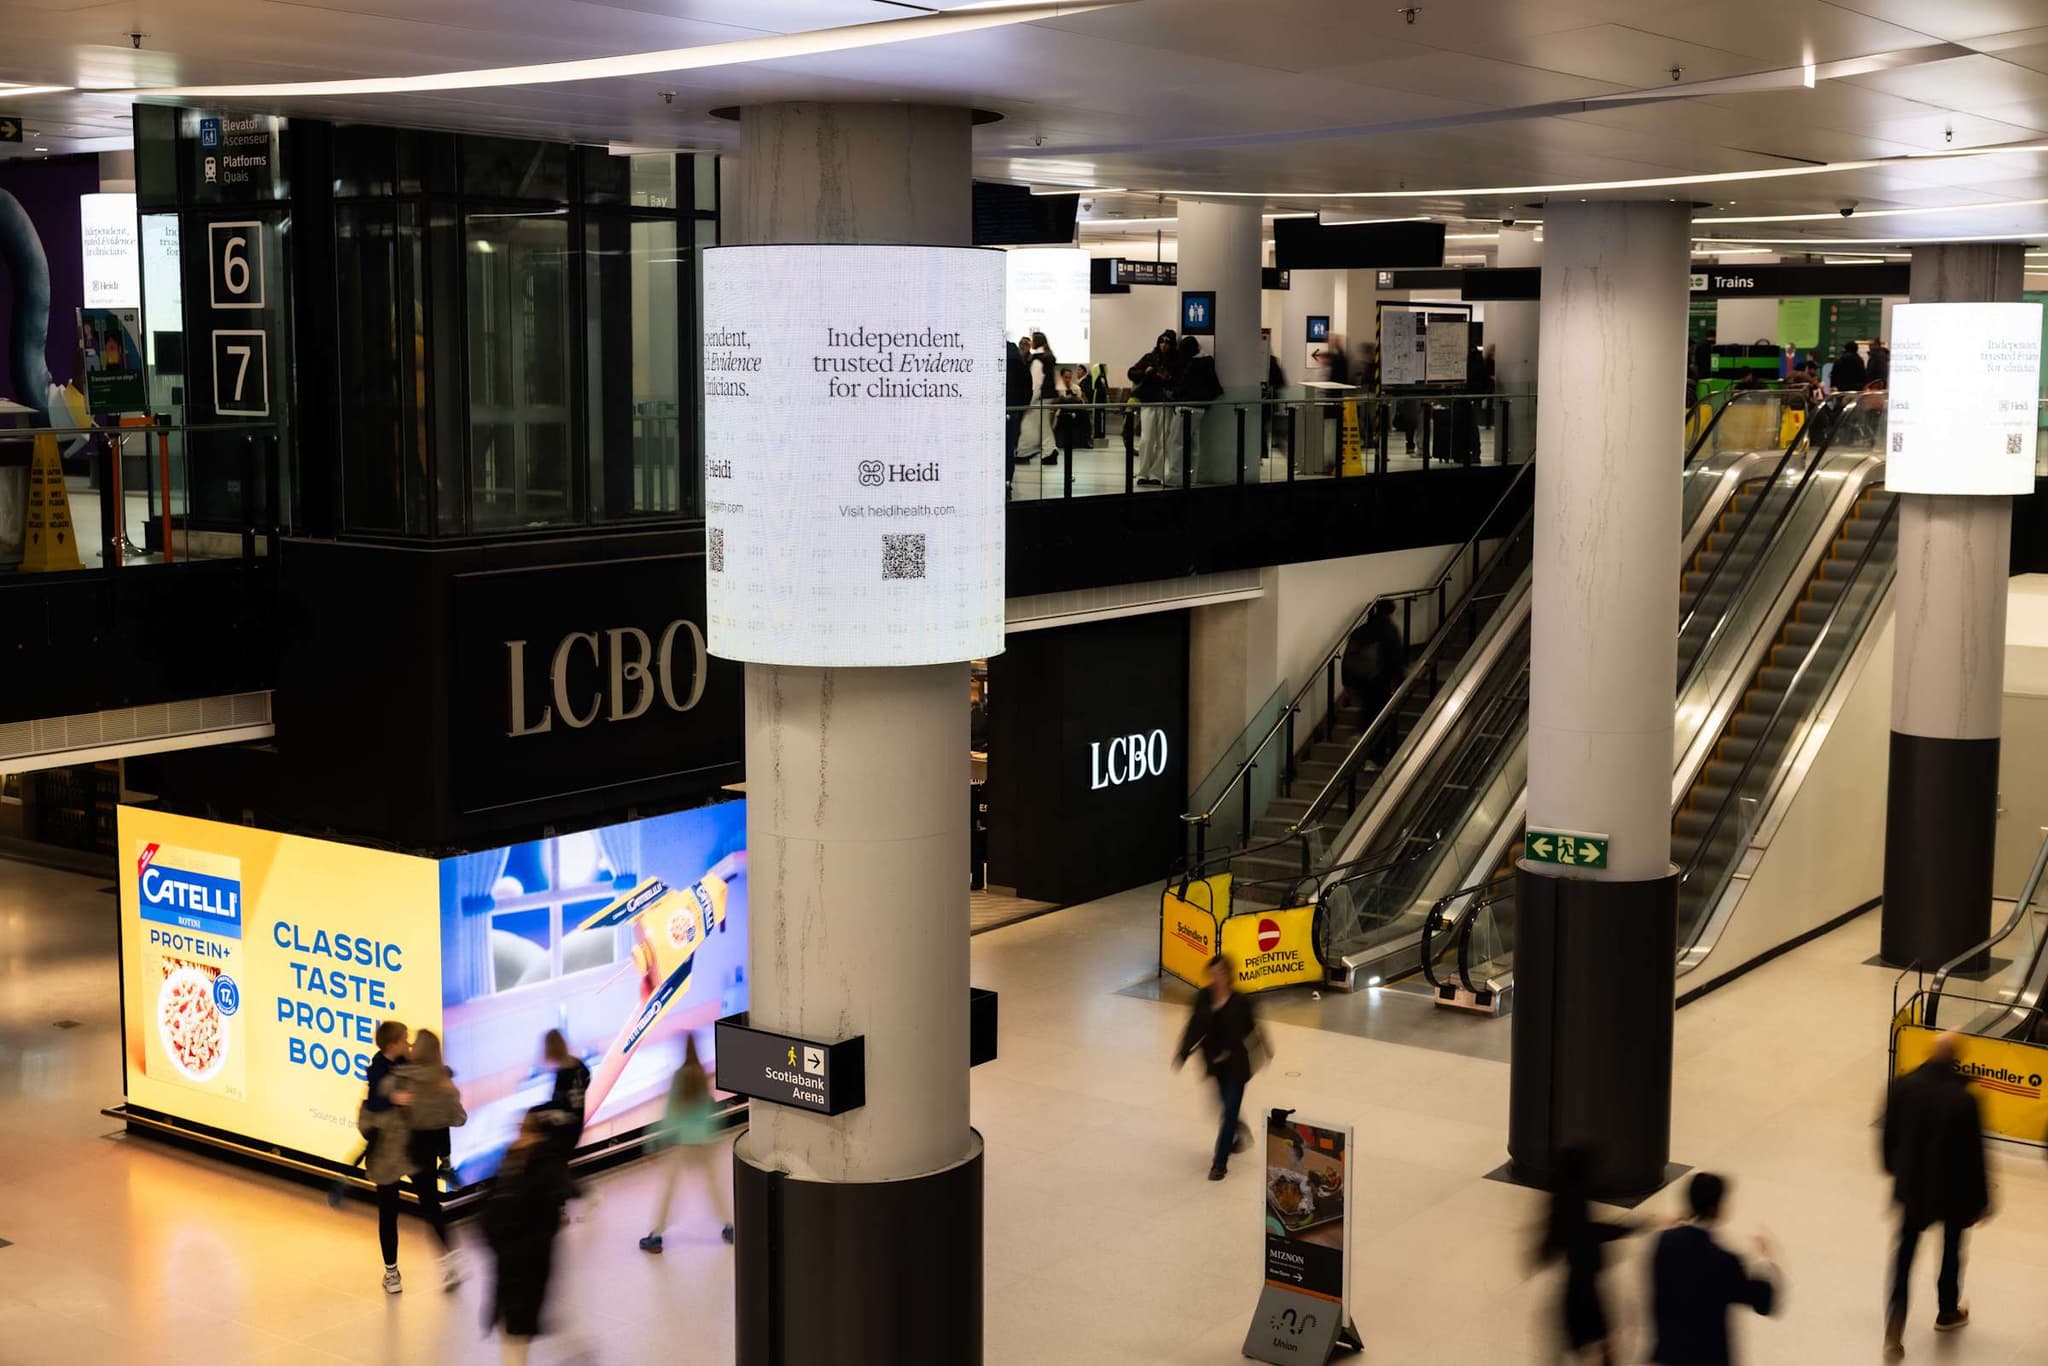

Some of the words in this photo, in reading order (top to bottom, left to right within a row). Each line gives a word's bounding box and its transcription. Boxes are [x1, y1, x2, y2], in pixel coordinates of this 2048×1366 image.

[222, 119, 258, 132] Elevator
[222, 134, 269, 146] Ascenseur
[223, 155, 267, 168] Platforms
[223, 170, 249, 183] Quais
[649, 194, 668, 207] Bay
[223, 236, 250, 294] 6
[1714, 276, 1754, 288] Trains
[827, 326, 965, 354] Independent,
[226, 345, 251, 401] 7
[708, 353, 762, 373] Evidence
[813, 352, 894, 373] trusted
[899, 353, 974, 374] Evidence
[828, 376, 862, 398] for
[866, 377, 963, 398] clinicians.
[708, 459, 732, 479] Heidi
[888, 462, 940, 482] Heidi
[839, 505, 865, 518] Visit
[867, 504, 956, 518] heidihealth.com
[504, 618, 708, 738] LCBO
[1090, 728, 1168, 790] LCBO
[142, 868, 238, 918] CATELLI
[1177, 920, 1204, 944] Schindler
[150, 928, 231, 959] PROTEIN+
[273, 921, 403, 972] CLASSIC
[1245, 950, 1299, 969] PREVENTIVE
[1239, 961, 1305, 983] MAINTENANCE
[289, 962, 397, 1011] TASTE.
[288, 1036, 372, 1083] BOOS
[765, 1066, 825, 1091] Scotiabank
[1951, 1059, 2025, 1085] Schindler
[792, 1087, 825, 1105] Arena
[1269, 1248, 1305, 1265] MIZNON
[1273, 1337, 1299, 1353] Union
